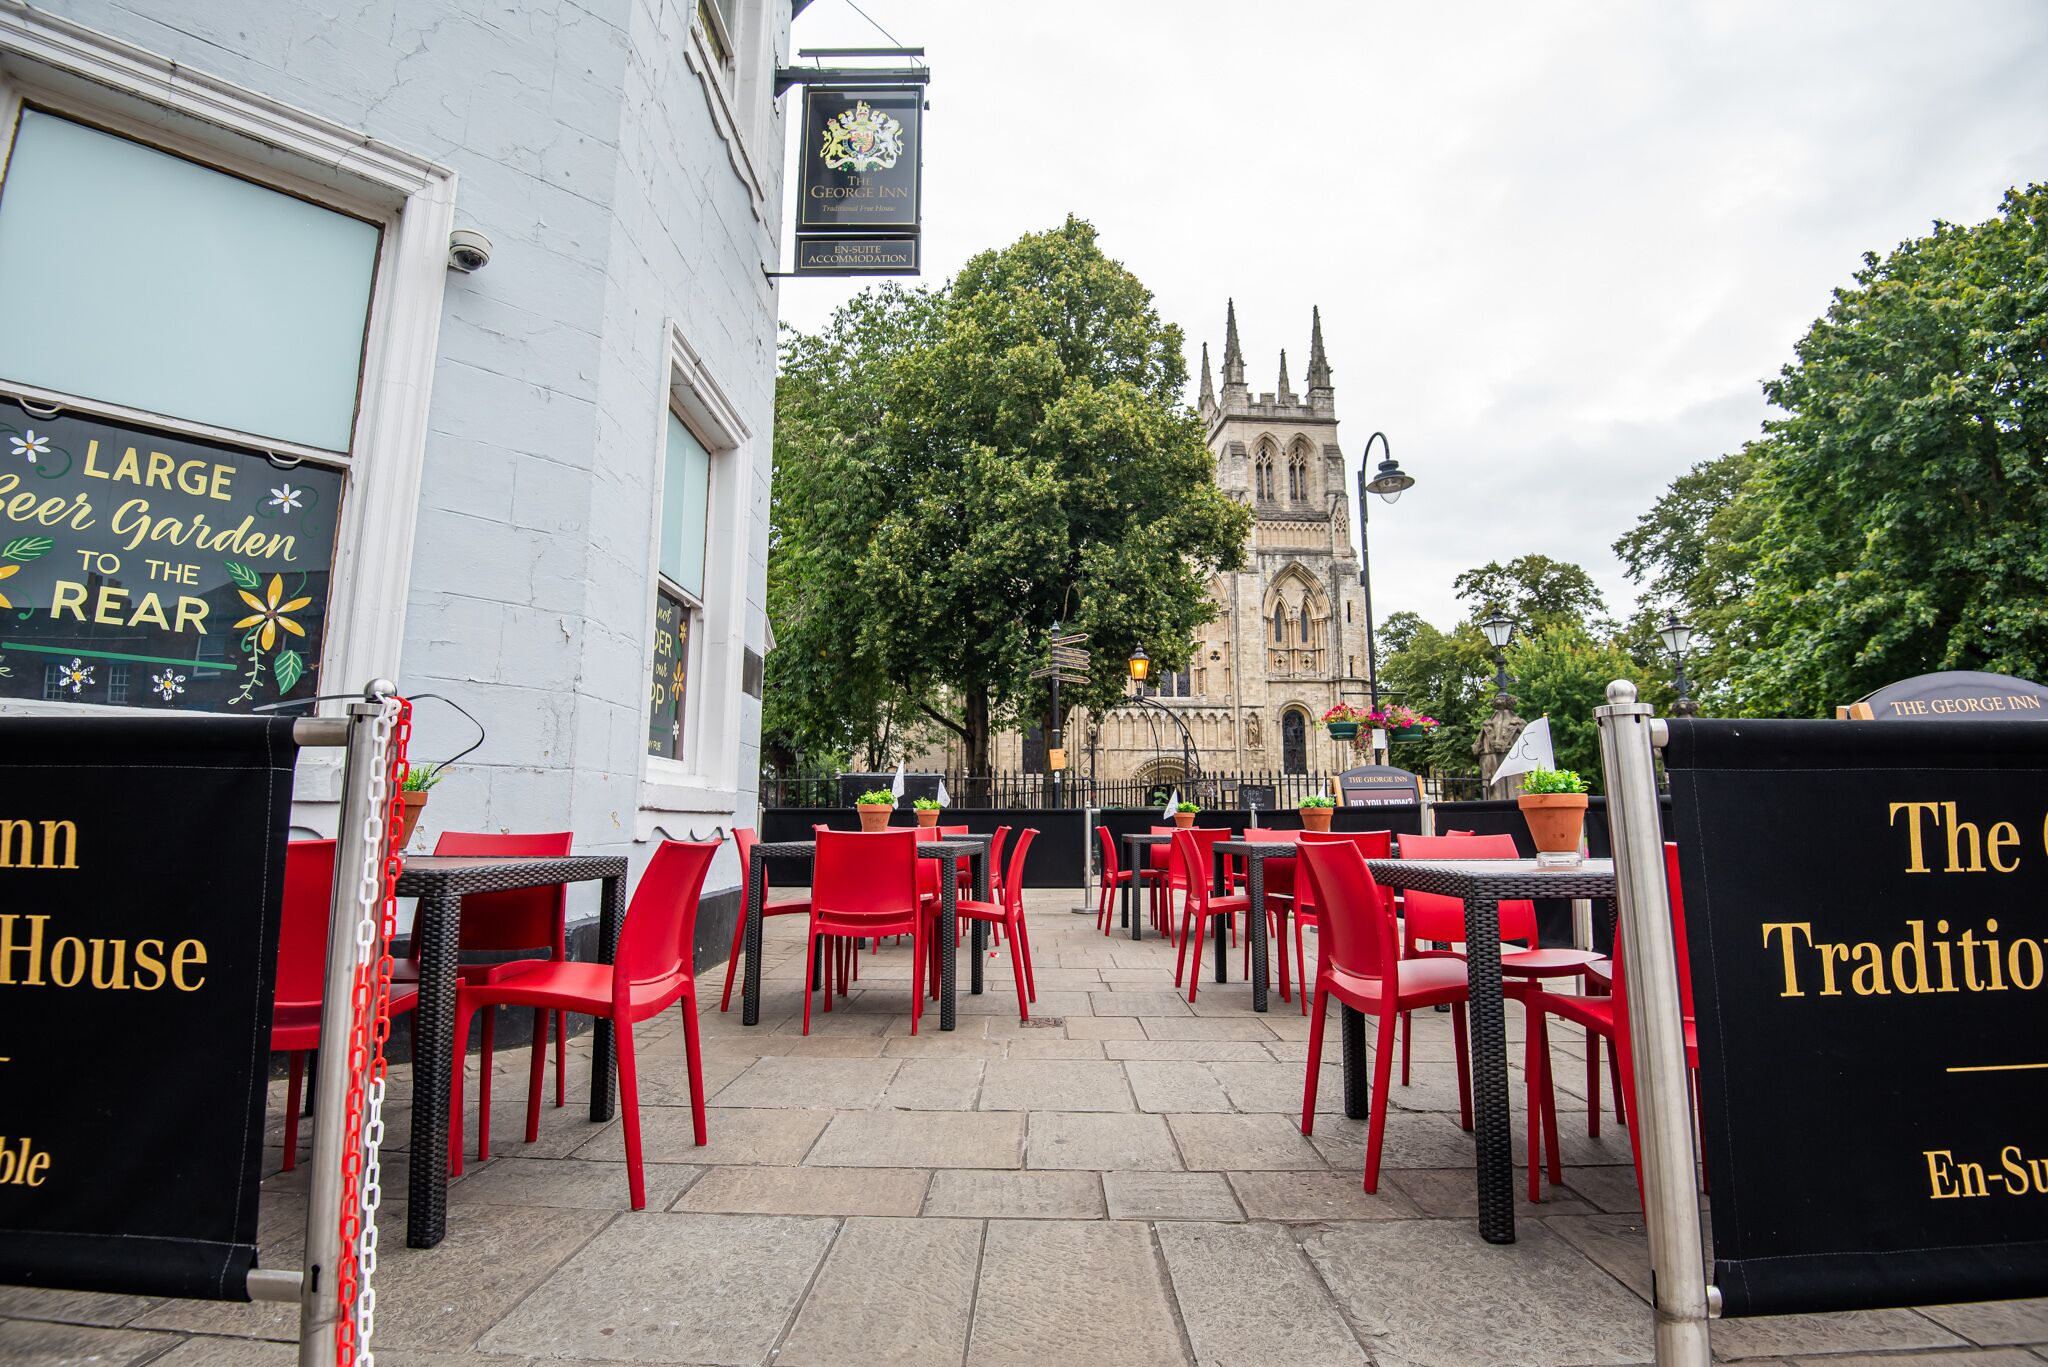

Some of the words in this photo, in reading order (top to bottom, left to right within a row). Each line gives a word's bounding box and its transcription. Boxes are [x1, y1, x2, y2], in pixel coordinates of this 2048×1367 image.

[811, 185, 874, 199] GEORGE
[879, 185, 908, 198] INN
[847, 175, 873, 186] THE
[808, 254, 907, 263] ACCOMMODATION
[834, 245, 882, 254] EN-SUITE
[83, 439, 237, 501] LARGE
[111, 498, 298, 562] Garden
[76, 549, 121, 575] TO
[144, 558, 201, 586] THE
[50, 579, 210, 635] REAR
[1890, 700, 1929, 716] THE
[1931, 696, 2006, 714] GEORGE
[2007, 695, 2042, 710] INN
[1888, 801, 2021, 873] The
[0, 914, 208, 992] House
[1761, 917, 2048, 999] Traditio
